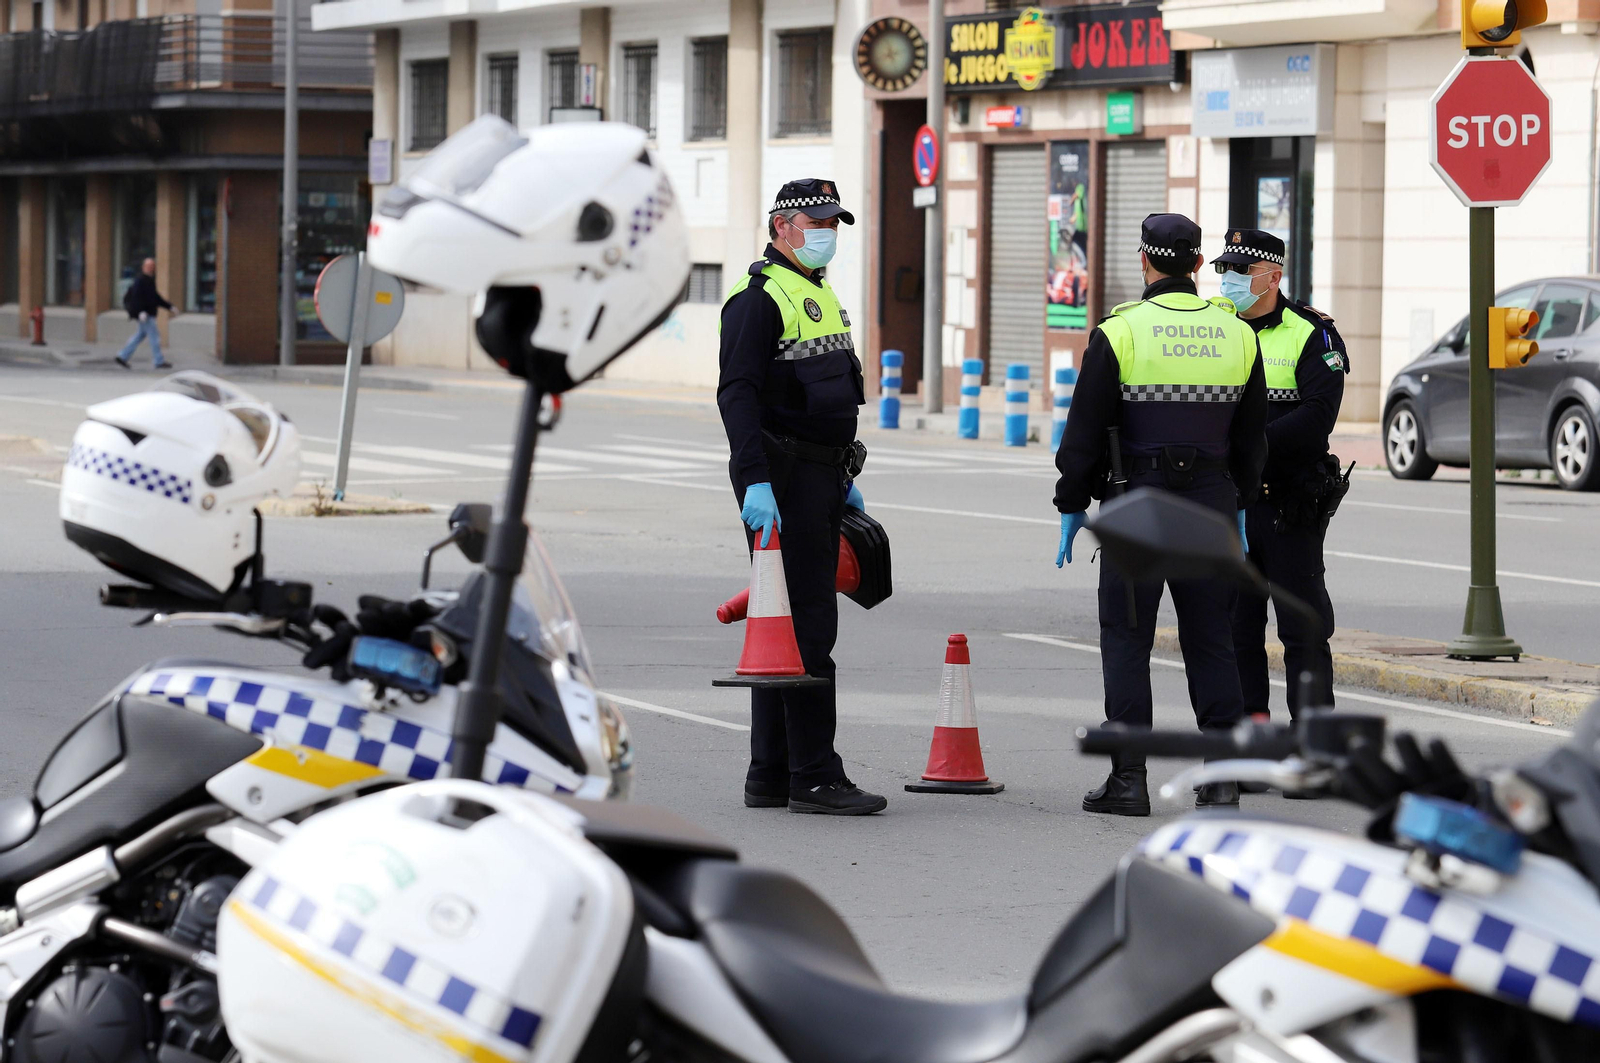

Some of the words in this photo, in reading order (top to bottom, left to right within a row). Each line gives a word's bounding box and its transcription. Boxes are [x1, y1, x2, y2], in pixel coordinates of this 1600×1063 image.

[950, 21, 999, 52] SALON
[1071, 17, 1170, 69] JOKER
[959, 53, 1009, 84] JUEGO
[1447, 114, 1541, 149] STOP
[1152, 325, 1226, 339] POLICIA
[1162, 344, 1222, 358] LOCAL
[1263, 357, 1296, 368] POLICIA
